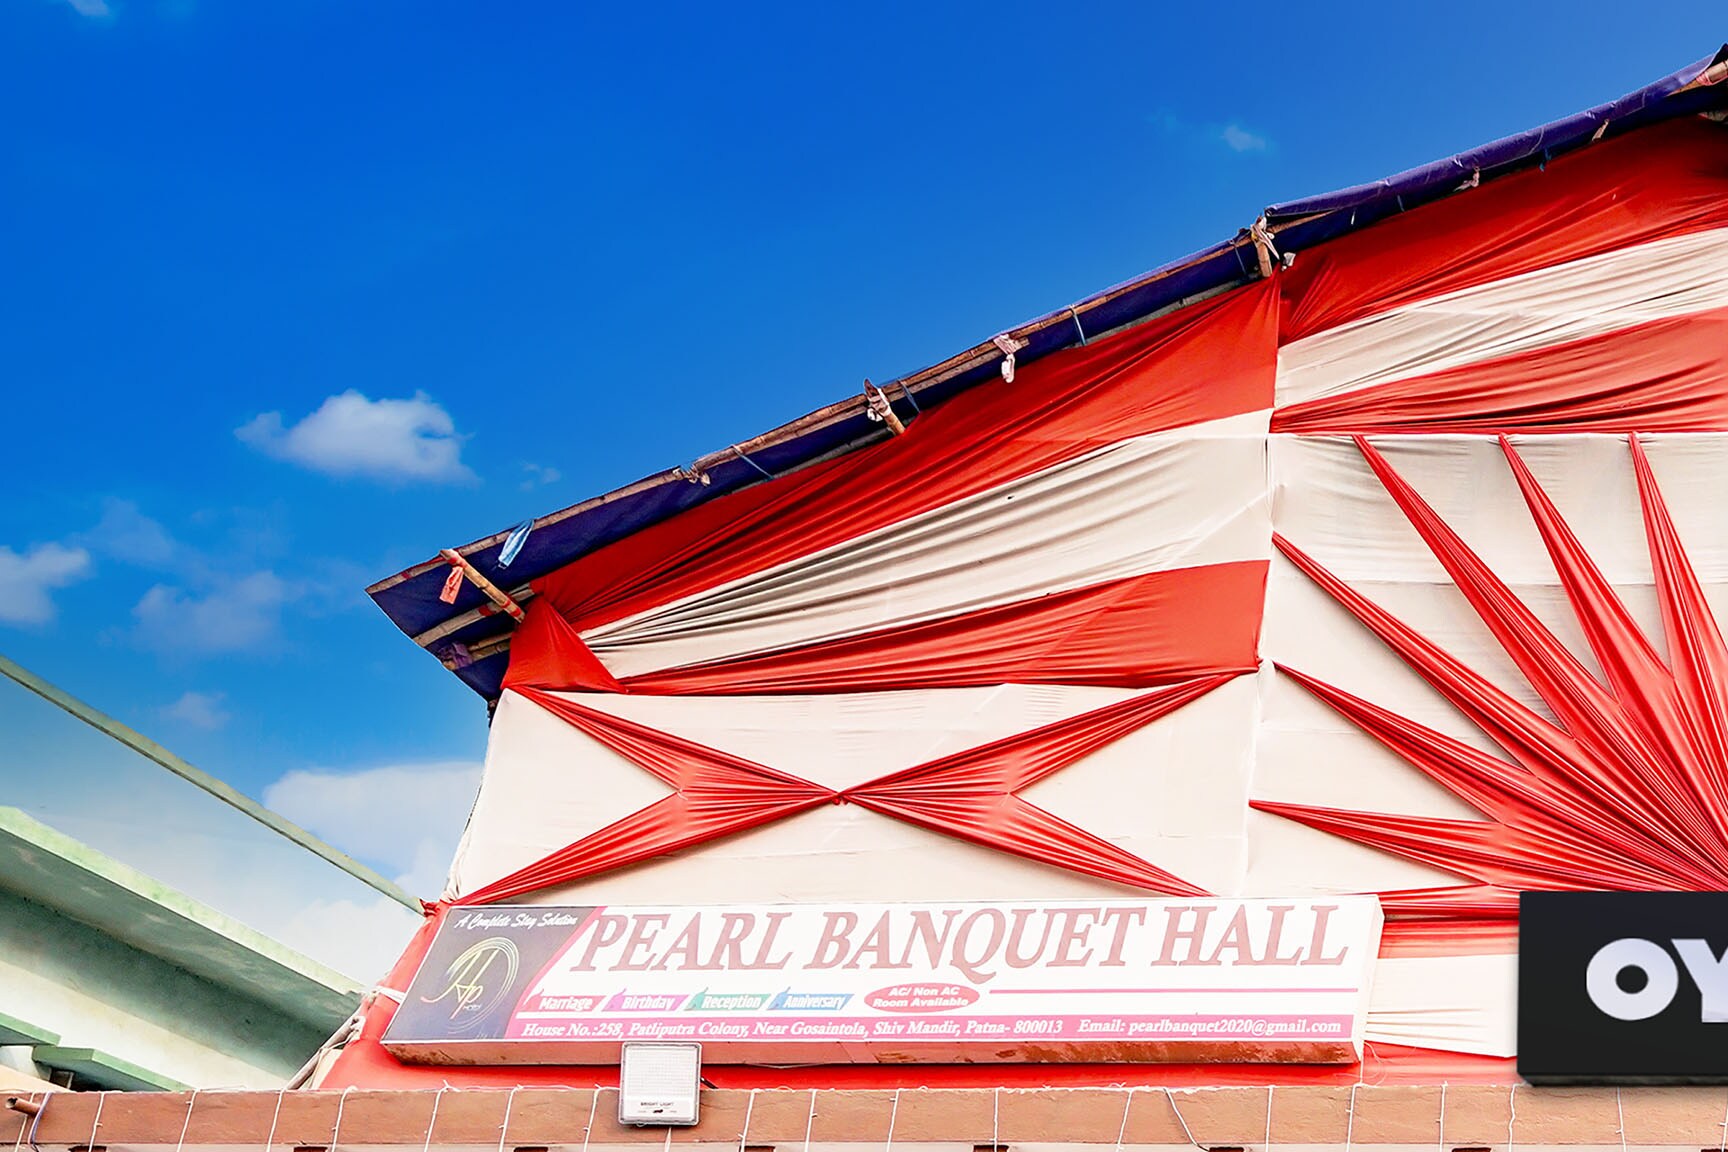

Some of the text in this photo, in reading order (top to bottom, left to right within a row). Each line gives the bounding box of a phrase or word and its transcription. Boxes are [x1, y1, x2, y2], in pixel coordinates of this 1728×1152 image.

[453, 912, 578, 930] A Complete Stay Solution
[569, 905, 1349, 985] PEARL BANQUET HALL
[914, 987, 940, 996] Non
[943, 986, 960, 996] AC
[538, 996, 593, 1011] Marriage
[621, 995, 676, 1011] Birthday
[703, 995, 762, 1011] Reception
[783, 995, 847, 1010] Anniversary
[872, 997, 969, 1008] Room Available
[521, 1019, 1063, 1039] House No.:258, Patliputra Colony, Near Gosaintola, Shiv Mandir, Patna- 800013
[1077, 1018, 1341, 1037] Email: pearlbanquet2020@gmail.com
